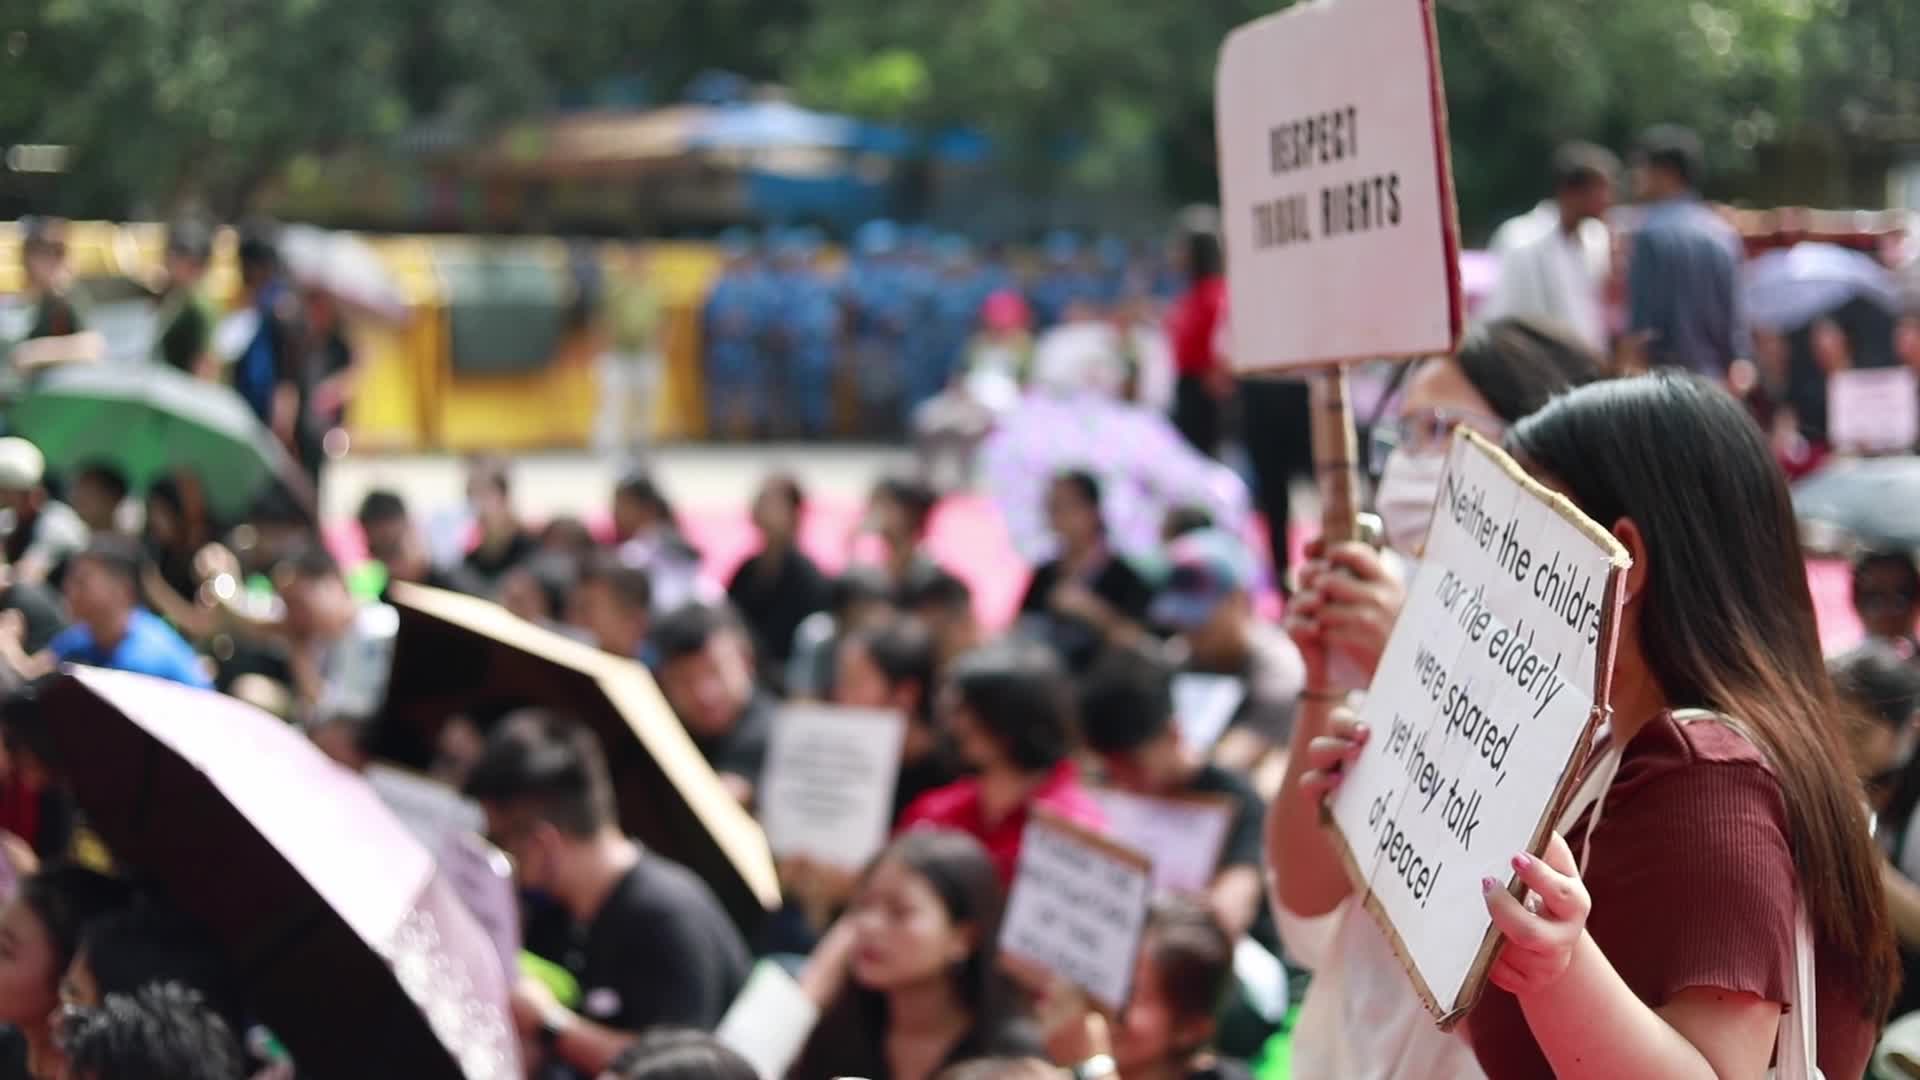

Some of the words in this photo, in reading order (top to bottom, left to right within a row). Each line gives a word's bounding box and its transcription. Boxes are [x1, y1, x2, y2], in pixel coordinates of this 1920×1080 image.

[1320, 171, 1401, 236] RIGHTS
[1447, 472, 1499, 551] Neither
[1500, 517, 1531, 582] the
[1534, 551, 1600, 645] childre
[1436, 569, 1468, 608] nor
[1459, 583, 1491, 642] the
[1488, 618, 1567, 720] elderly
[1383, 712, 1415, 755] yet
[1405, 731, 1445, 813] they
[1441, 778, 1482, 851] talk
[1413, 643, 1447, 701] were
[1442, 680, 1520, 787] spared,
[1369, 789, 1393, 833] of
[1374, 820, 1442, 908] peace!
